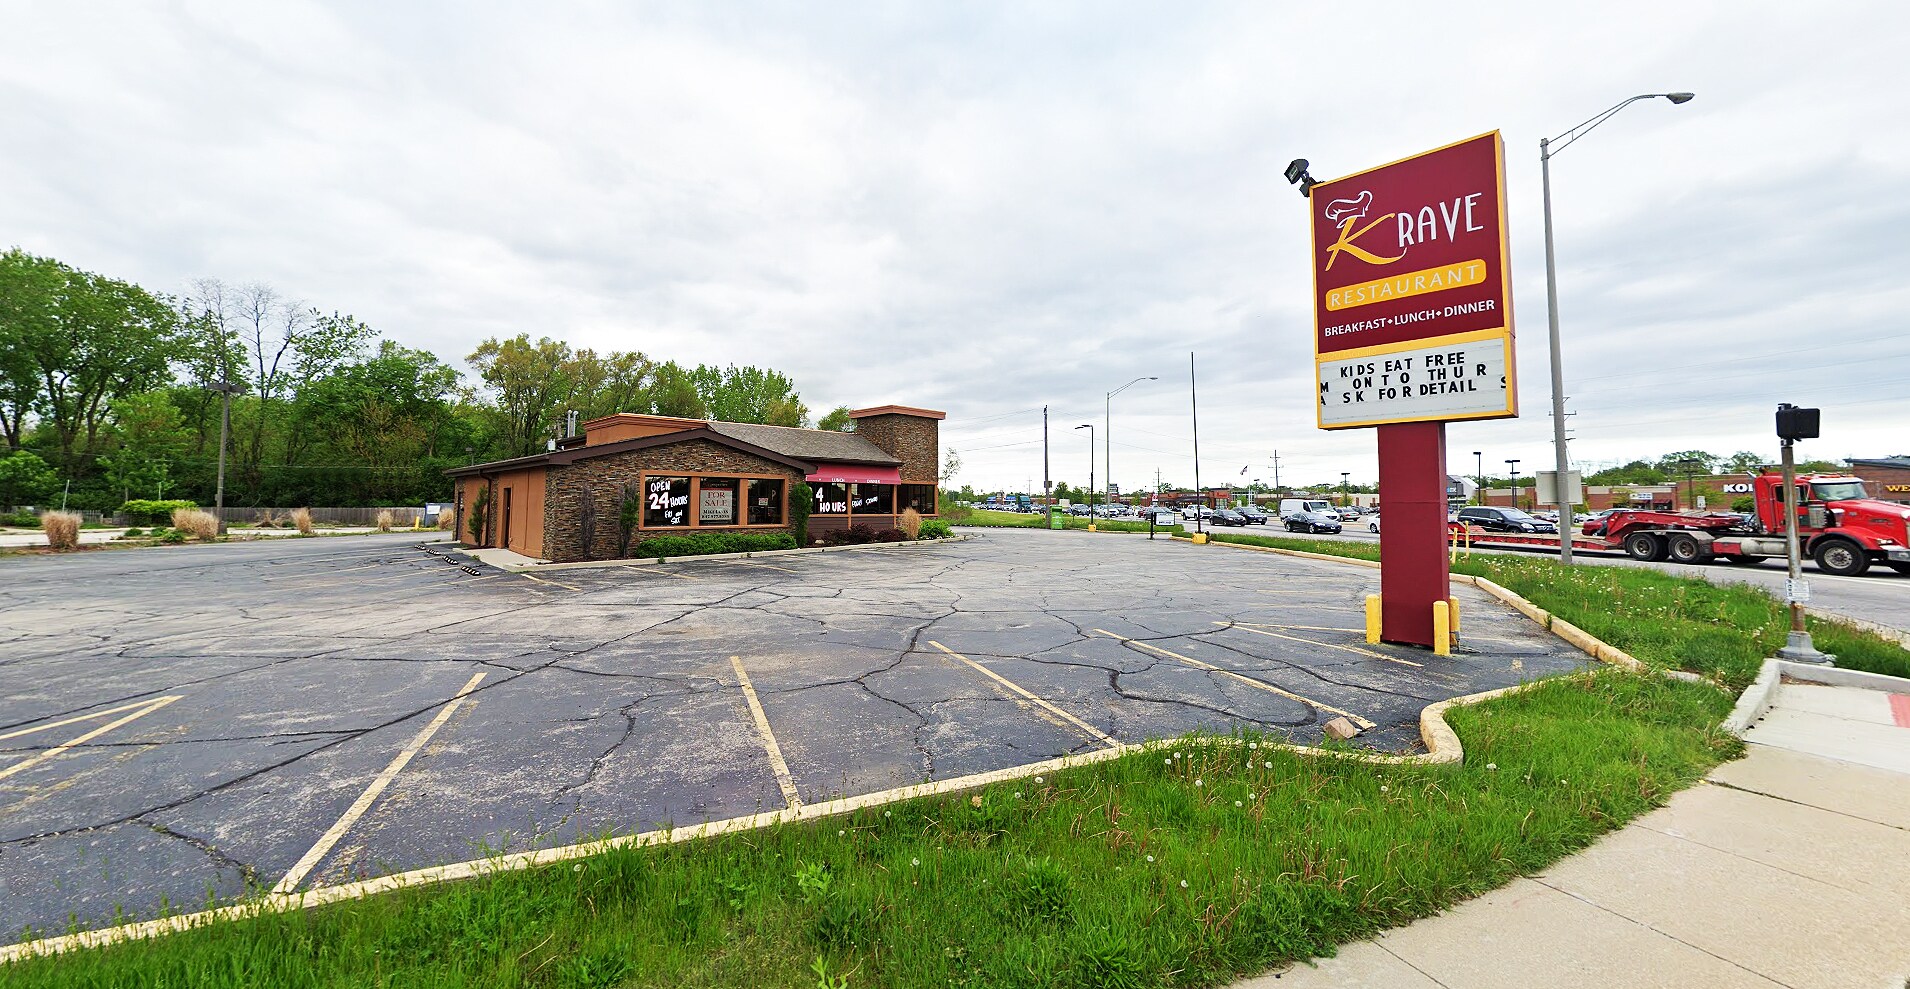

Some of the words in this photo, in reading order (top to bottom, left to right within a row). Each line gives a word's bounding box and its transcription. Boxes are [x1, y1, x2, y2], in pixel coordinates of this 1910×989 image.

[1325, 192, 1484, 271] KRAVE
[1330, 264, 1481, 307] RESTAURANT
[1324, 318, 1387, 337] BREAKFAST
[1394, 309, 1436, 326] LUNCH
[1444, 299, 1495, 318] DINNER
[1340, 363, 1375, 378] KIDS
[1385, 358, 1413, 372] EAT
[1425, 351, 1465, 367] FREE
[1379, 385, 1412, 399] FOR
[650, 481, 671, 492] OPEN
[1723, 483, 1753, 493] KO
[648, 491, 670, 510] 24
[670, 495, 688, 507] HOURS
[707, 491, 725, 499] FOR
[820, 501, 847, 512] HOURS
